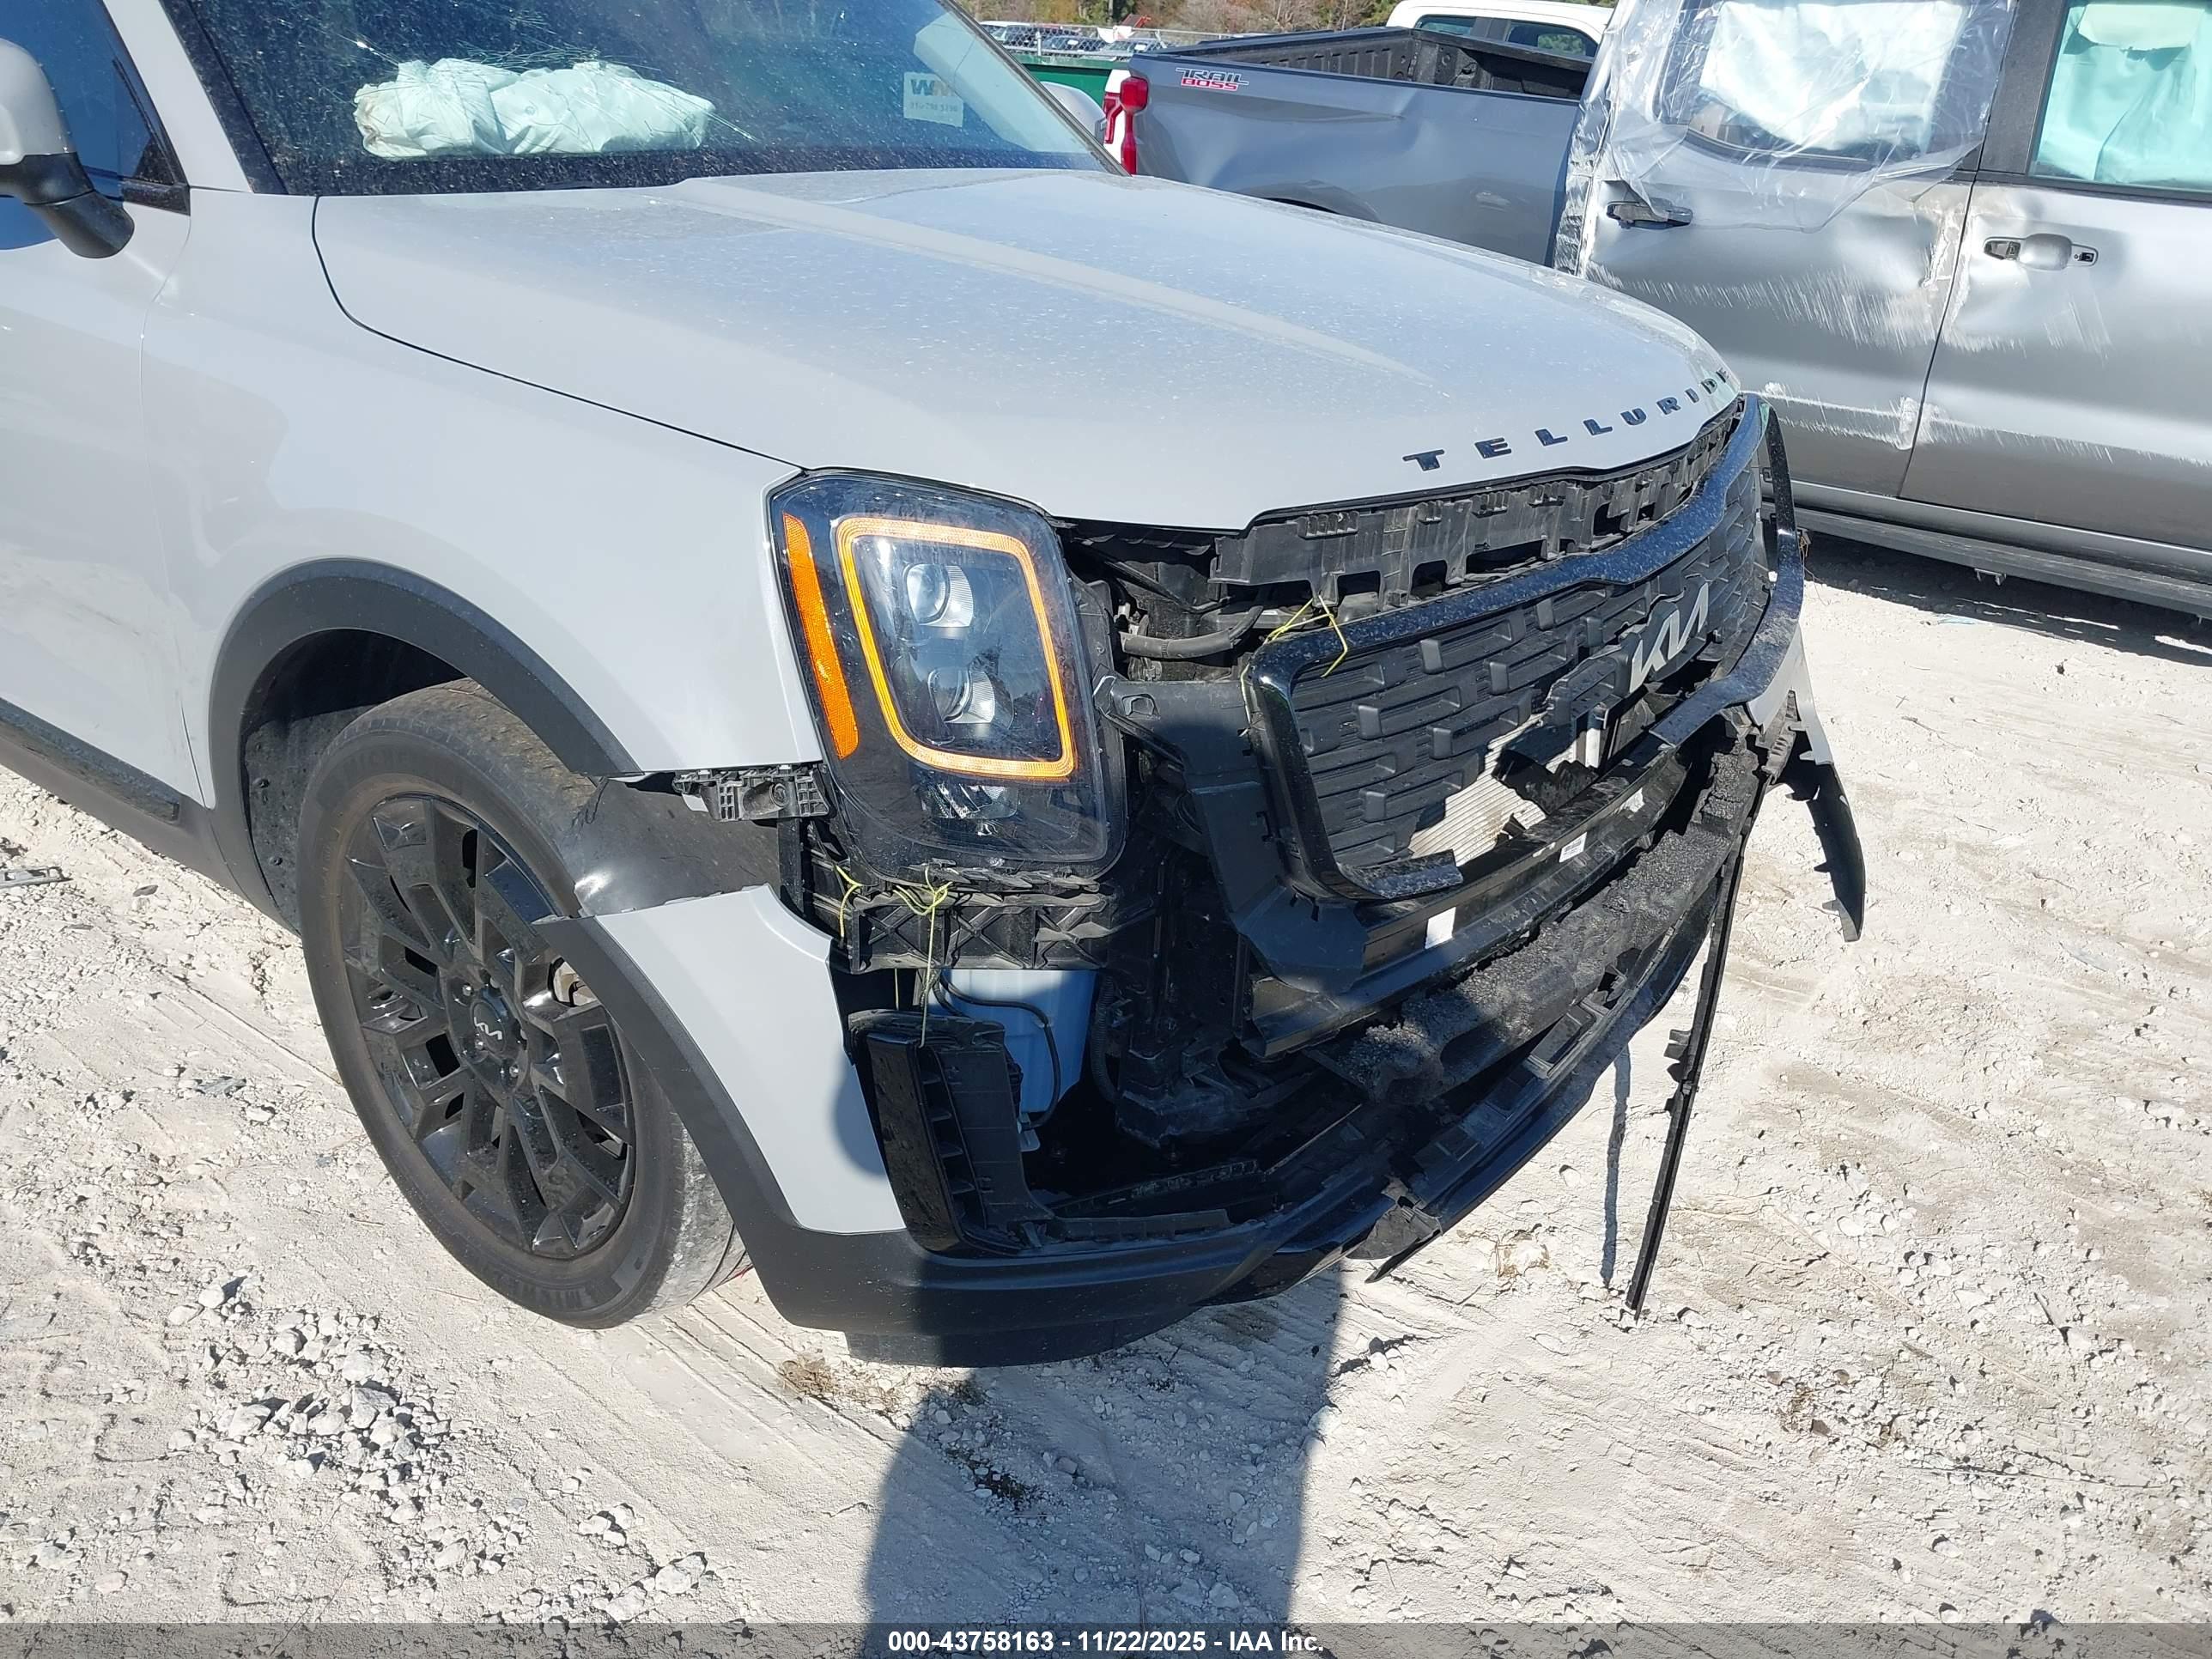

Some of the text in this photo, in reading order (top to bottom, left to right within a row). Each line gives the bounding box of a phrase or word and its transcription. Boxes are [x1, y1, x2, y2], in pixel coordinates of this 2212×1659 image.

[1176, 68, 1249, 85] TRAIL
[1181, 78, 1238, 91] BOSS
[1402, 368, 1730, 471] TELLURIDE
[1629, 582, 1709, 693] KIA
